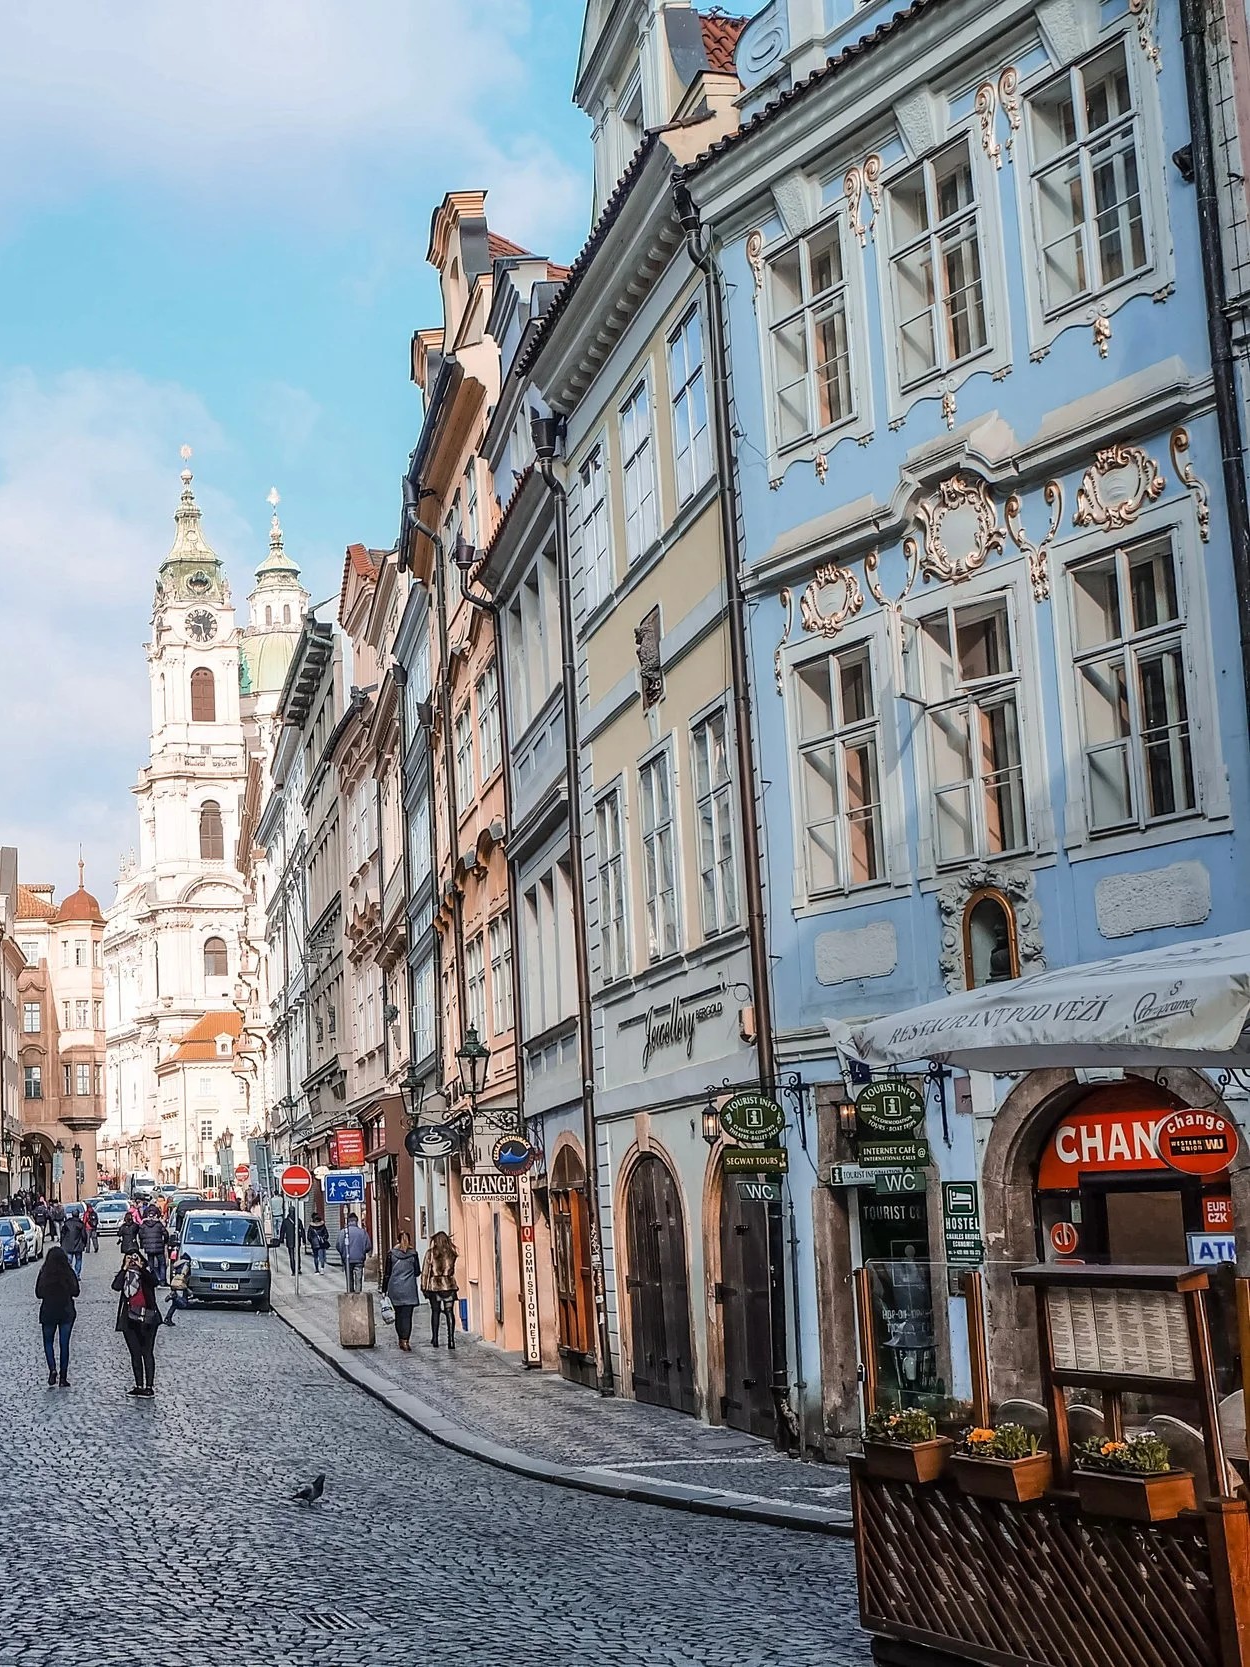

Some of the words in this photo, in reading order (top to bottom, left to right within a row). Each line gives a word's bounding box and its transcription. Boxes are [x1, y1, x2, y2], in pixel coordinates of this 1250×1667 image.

[1003, 1003, 1052, 1025] POD
[642, 995, 695, 1070] Jewellery
[695, 1002, 723, 1018] BERGOLD
[862, 1083, 896, 1101] TOURIST
[897, 1084, 916, 1100] INFO
[726, 1096, 758, 1112] TOURIST
[759, 1097, 778, 1112] INFO
[868, 1120, 886, 1131] TOURS
[1166, 1114, 1225, 1134] change
[863, 1146, 897, 1155] INTERNET
[898, 1144, 916, 1154] CAFÉ
[1170, 1139, 1203, 1147] WESTERN
[726, 1157, 754, 1165] SEGWAY
[755, 1156, 778, 1165] TOURS
[843, 1170, 865, 1179] TOURIST
[884, 1173, 916, 1192] WC
[462, 1175, 515, 1194] CHANGE
[745, 1184, 774, 1200] WC
[522, 1187, 530, 1224] LIMIT
[863, 1205, 906, 1220] TOURIST
[1206, 1201, 1226, 1212] EUR
[945, 1217, 980, 1230] HOSTEL
[1207, 1212, 1228, 1223] CZK
[525, 1244, 535, 1317] COMMISSION
[530, 1322, 538, 1359] NETTO
